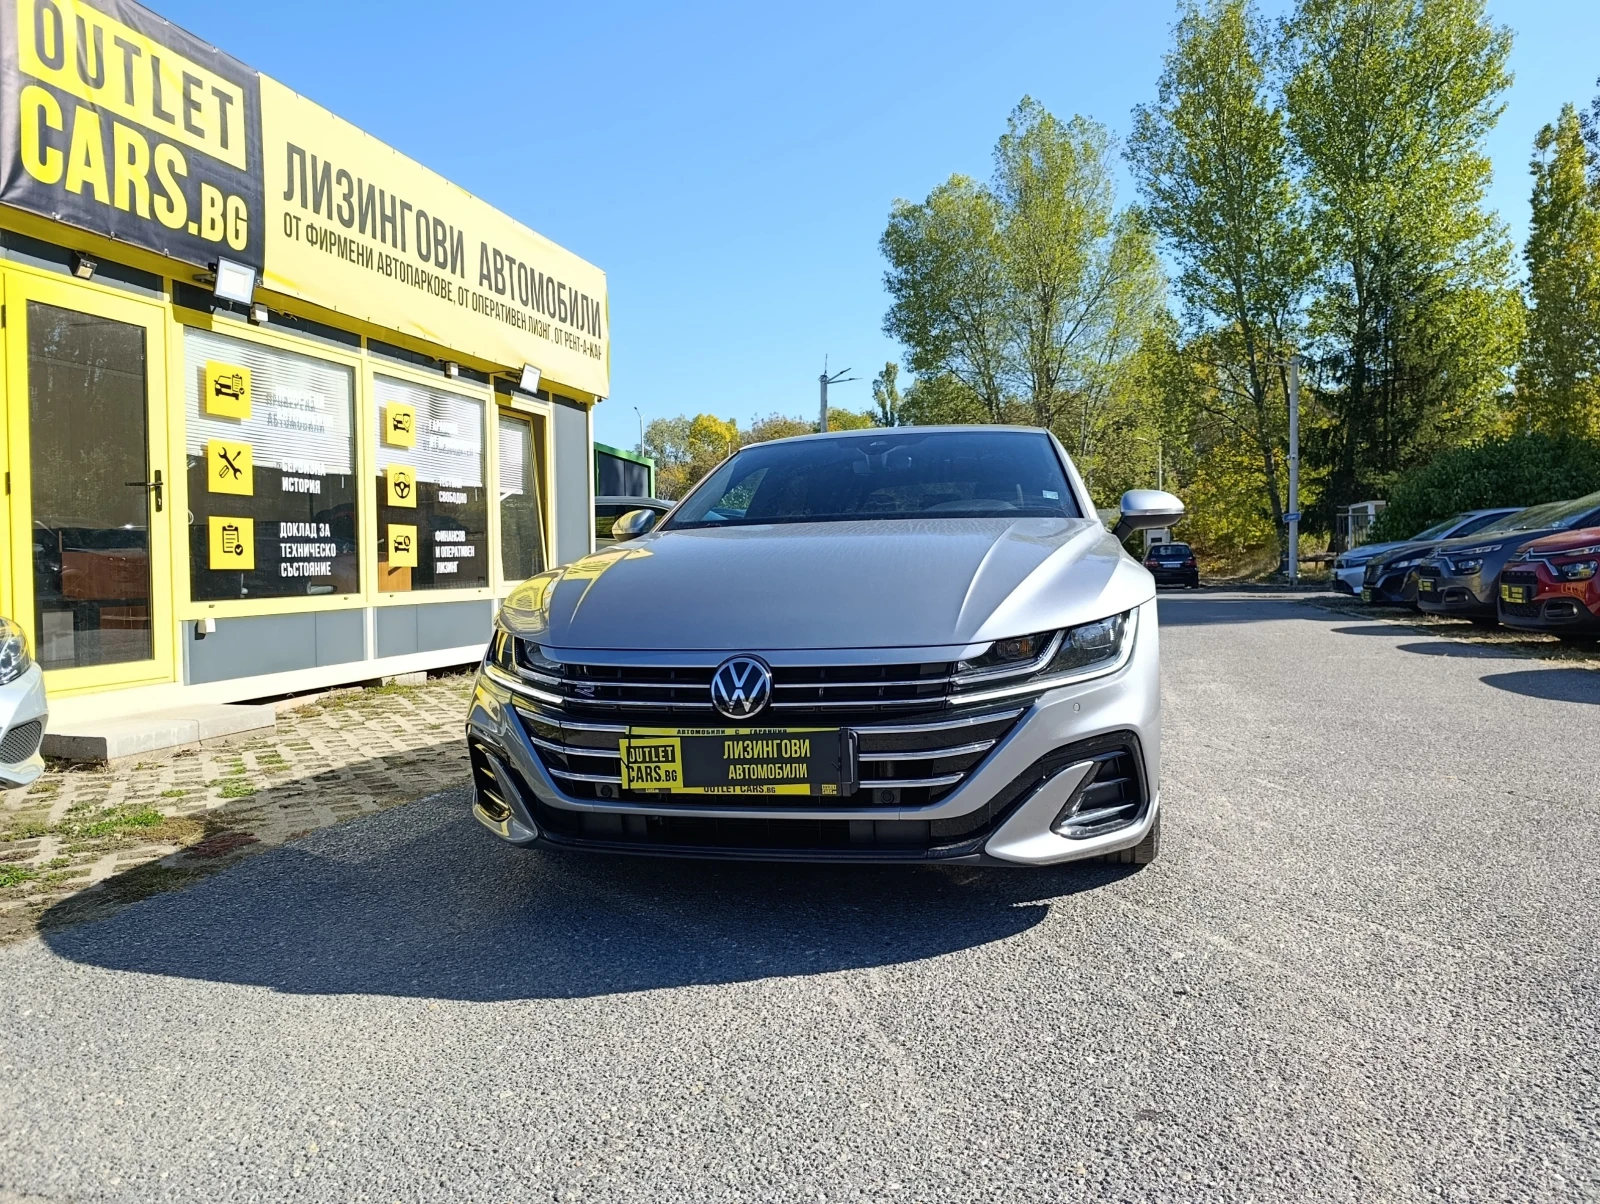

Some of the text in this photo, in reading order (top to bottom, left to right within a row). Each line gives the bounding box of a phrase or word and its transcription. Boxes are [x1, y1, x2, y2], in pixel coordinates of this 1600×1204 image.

[34, 0, 233, 150] OUTLET
[20, 85, 248, 251] CARS.BG
[283, 141, 602, 340] ЛИЗИНГОВИ АВТОМОБИЛИ
[283, 212, 302, 241] ОТ
[306, 222, 374, 270] ФИРМЕНИ
[377, 251, 456, 305] АВТОПАРКОВЕ,
[458, 286, 470, 308] ОТ
[471, 292, 527, 331] ОПЕРАТИВЕН
[554, 327, 564, 346] ОТ
[281, 476, 321, 494] ИСТОРИЯ
[279, 522, 331, 538] ДОКЛАД ЗА
[280, 543, 337, 557] ТЕХНИЧЕСКО
[441, 545, 475, 558] ОПЕРАТИВЕН
[280, 562, 332, 577] СЪСТОЯНИЕ
[629, 746, 673, 762] OUTLET
[723, 739, 811, 759] ЛИЗИНГОВИ
[629, 765, 678, 783] CARS.BG
[728, 763, 808, 779] АВТОМОБИЛИ
[703, 785, 737, 793] OUTLET
